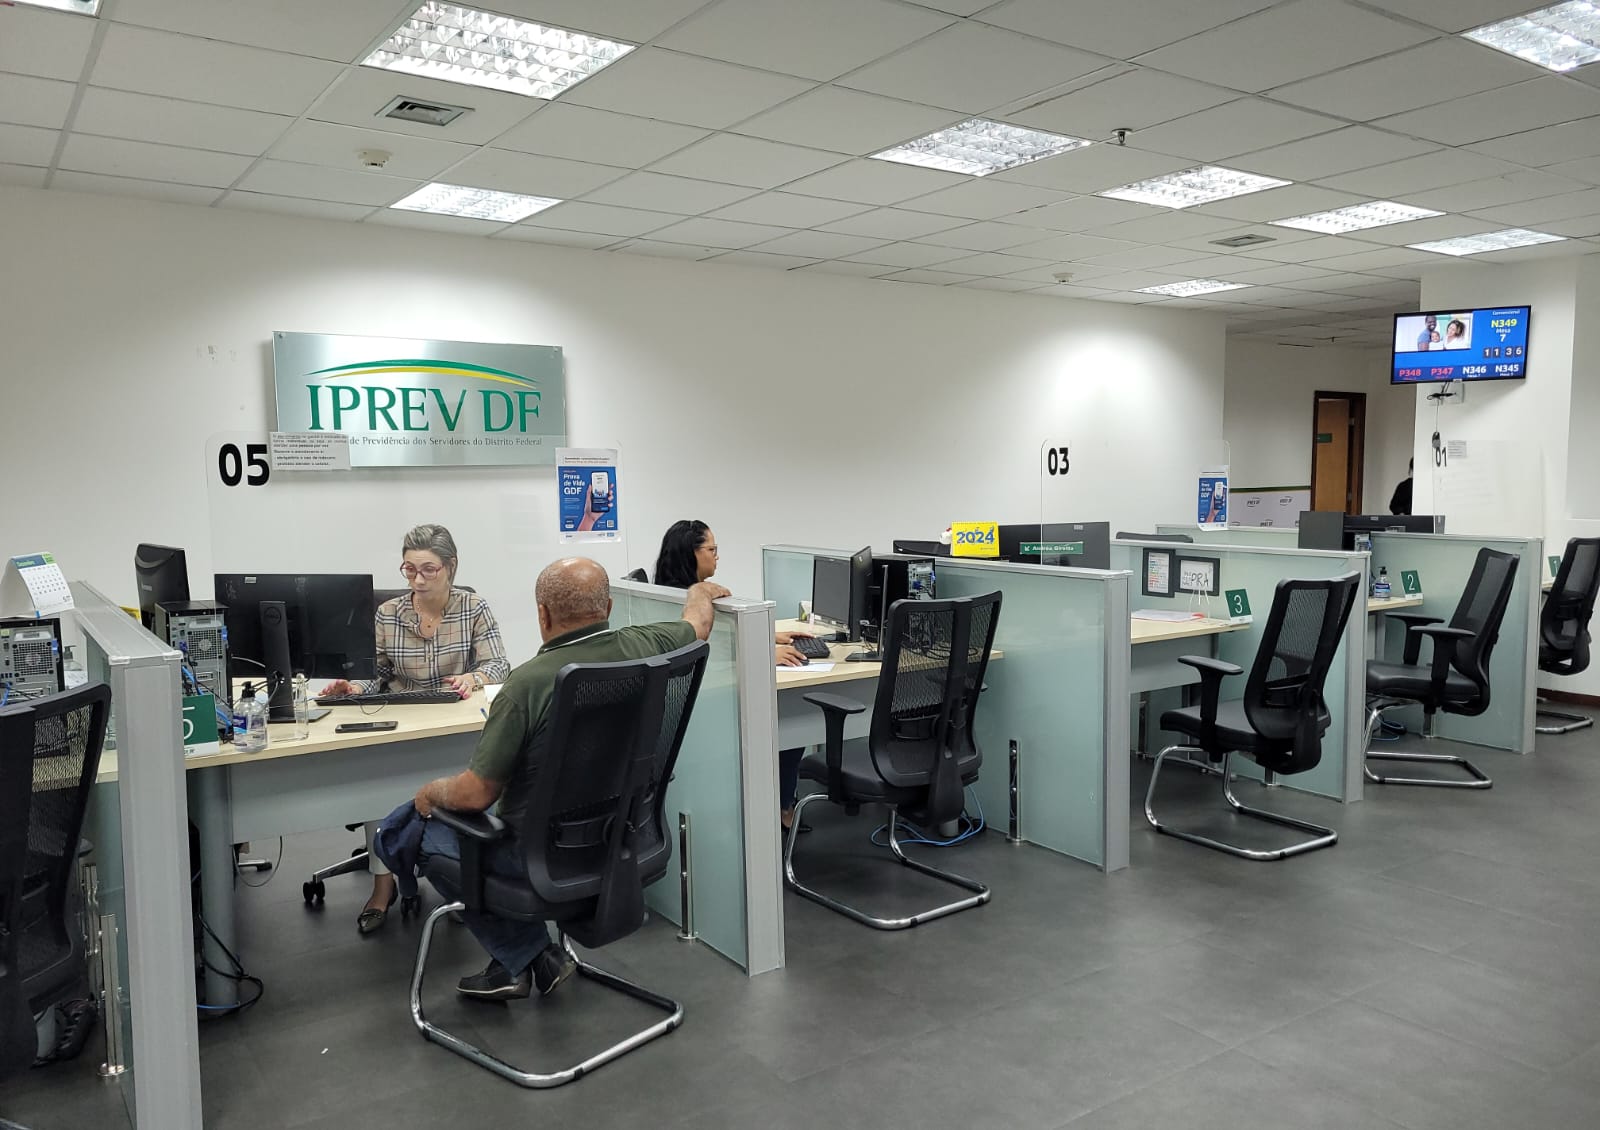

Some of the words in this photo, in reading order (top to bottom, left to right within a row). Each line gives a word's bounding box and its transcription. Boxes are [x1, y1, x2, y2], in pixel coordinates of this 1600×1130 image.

[1491, 318, 1517, 328] N349
[1500, 334, 1506, 342] 7
[1399, 369, 1421, 377] P348
[1431, 367, 1454, 375] P347
[1462, 365, 1487, 375] N346
[1495, 364, 1519, 373] N345
[305, 384, 467, 432] IPREV
[478, 389, 542, 433] DF
[349, 436, 360, 445] de
[362, 436, 410, 446] Previdência
[412, 437, 427, 446] dos
[429, 436, 471, 446] Servidores
[473, 436, 482, 446] do
[485, 437, 514, 446] Distrito
[516, 437, 542, 446] Federal
[1047, 447, 1070, 476] 03
[1435, 446, 1447, 467] 01
[218, 443, 270, 487] 05
[563, 487, 582, 495] GDF
[956, 530, 995, 545] 2024
[1407, 574, 1416, 591] 2
[1233, 594, 1243, 614] 3
